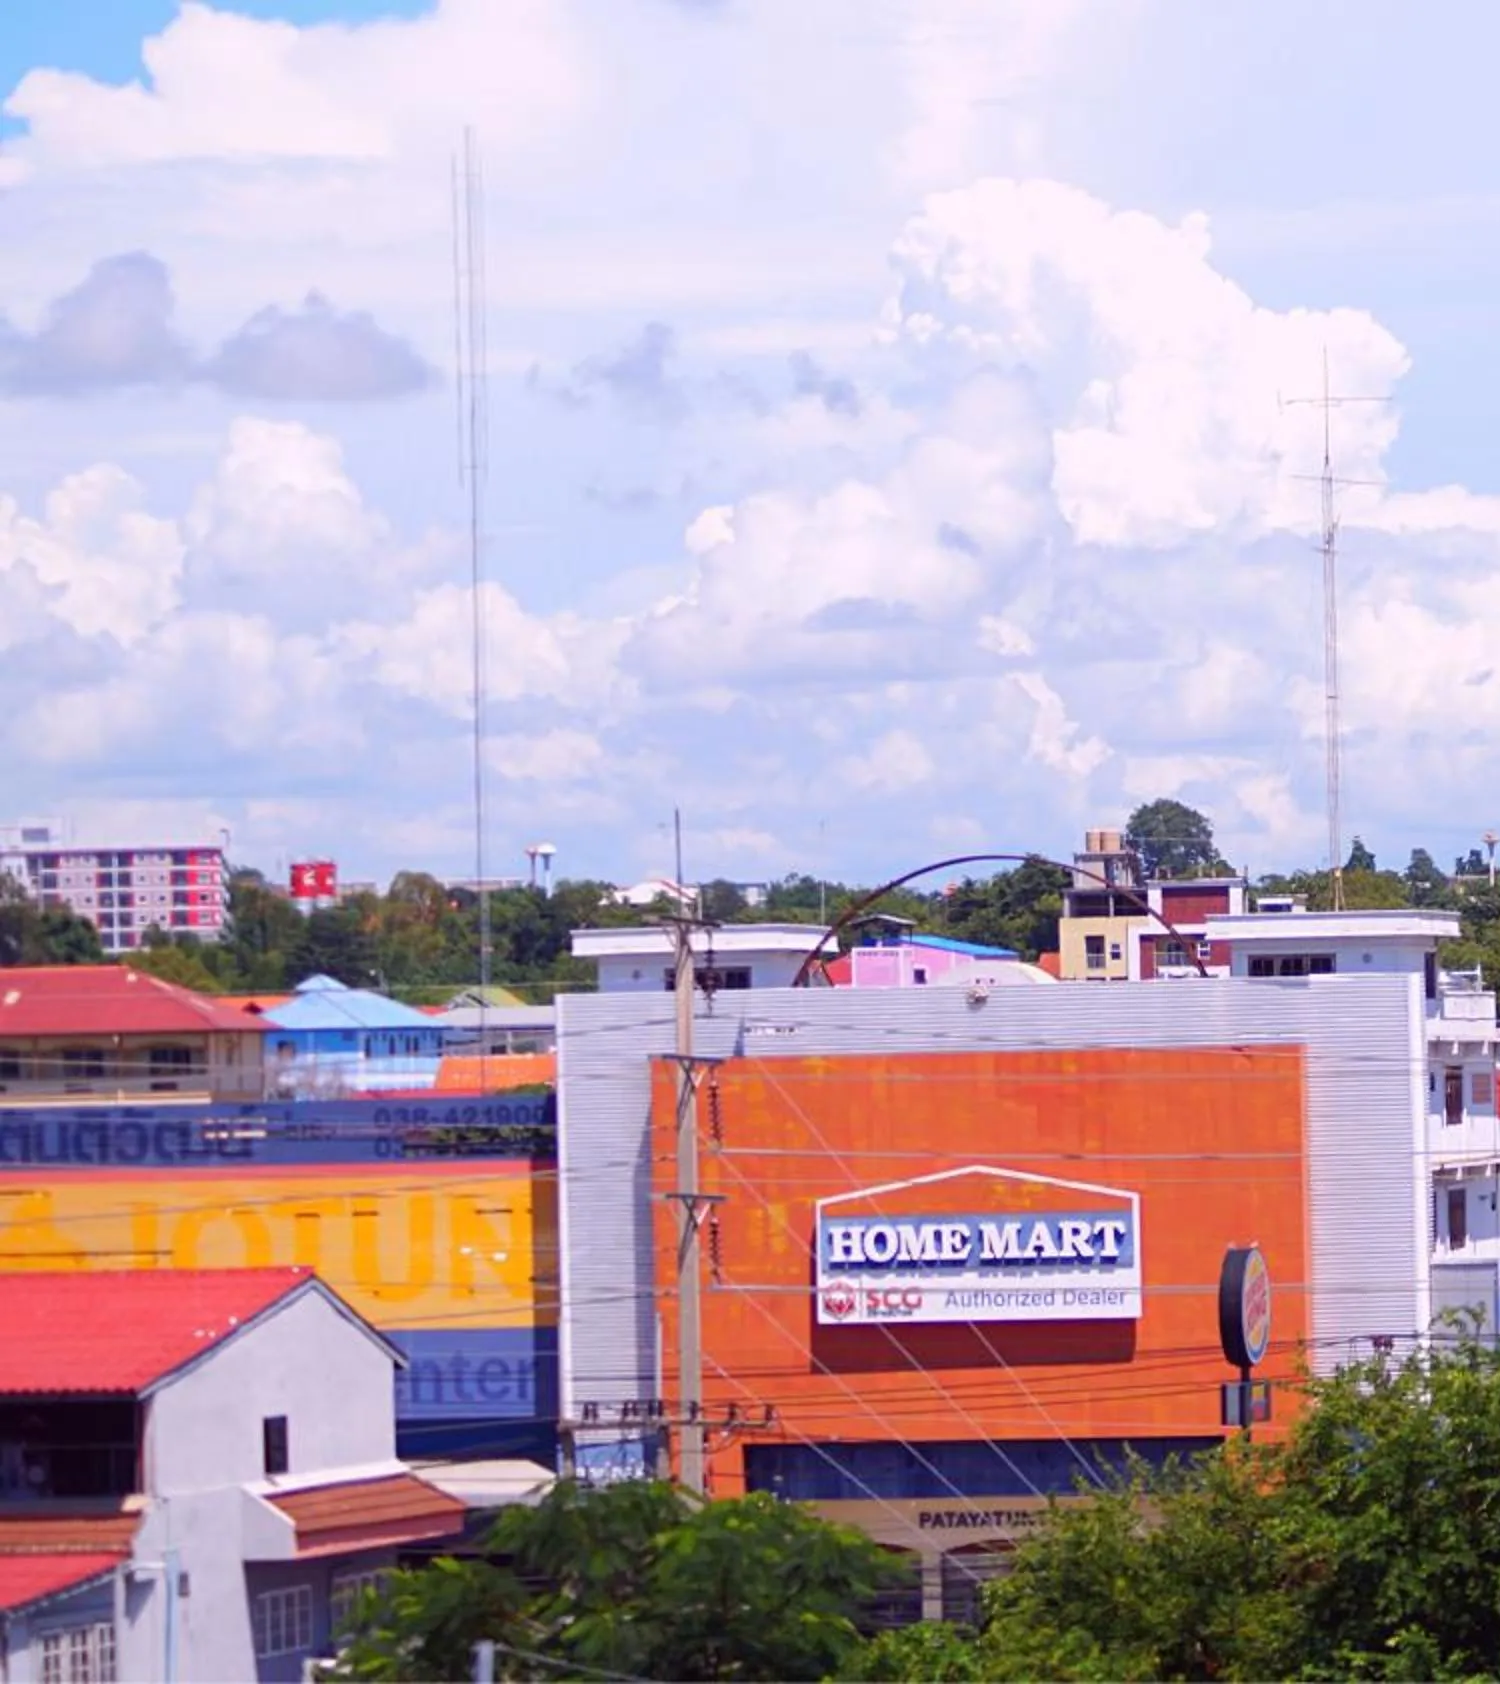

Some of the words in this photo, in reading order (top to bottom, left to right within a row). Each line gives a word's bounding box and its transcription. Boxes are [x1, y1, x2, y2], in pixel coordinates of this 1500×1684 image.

[829, 1224, 972, 1263] HOME
[979, 1220, 1126, 1260] MART
[866, 1287, 923, 1309] SCG
[945, 1287, 1056, 1309] Authorized
[1062, 1286, 1127, 1307] Dealer
[395, 1350, 538, 1404] nter
